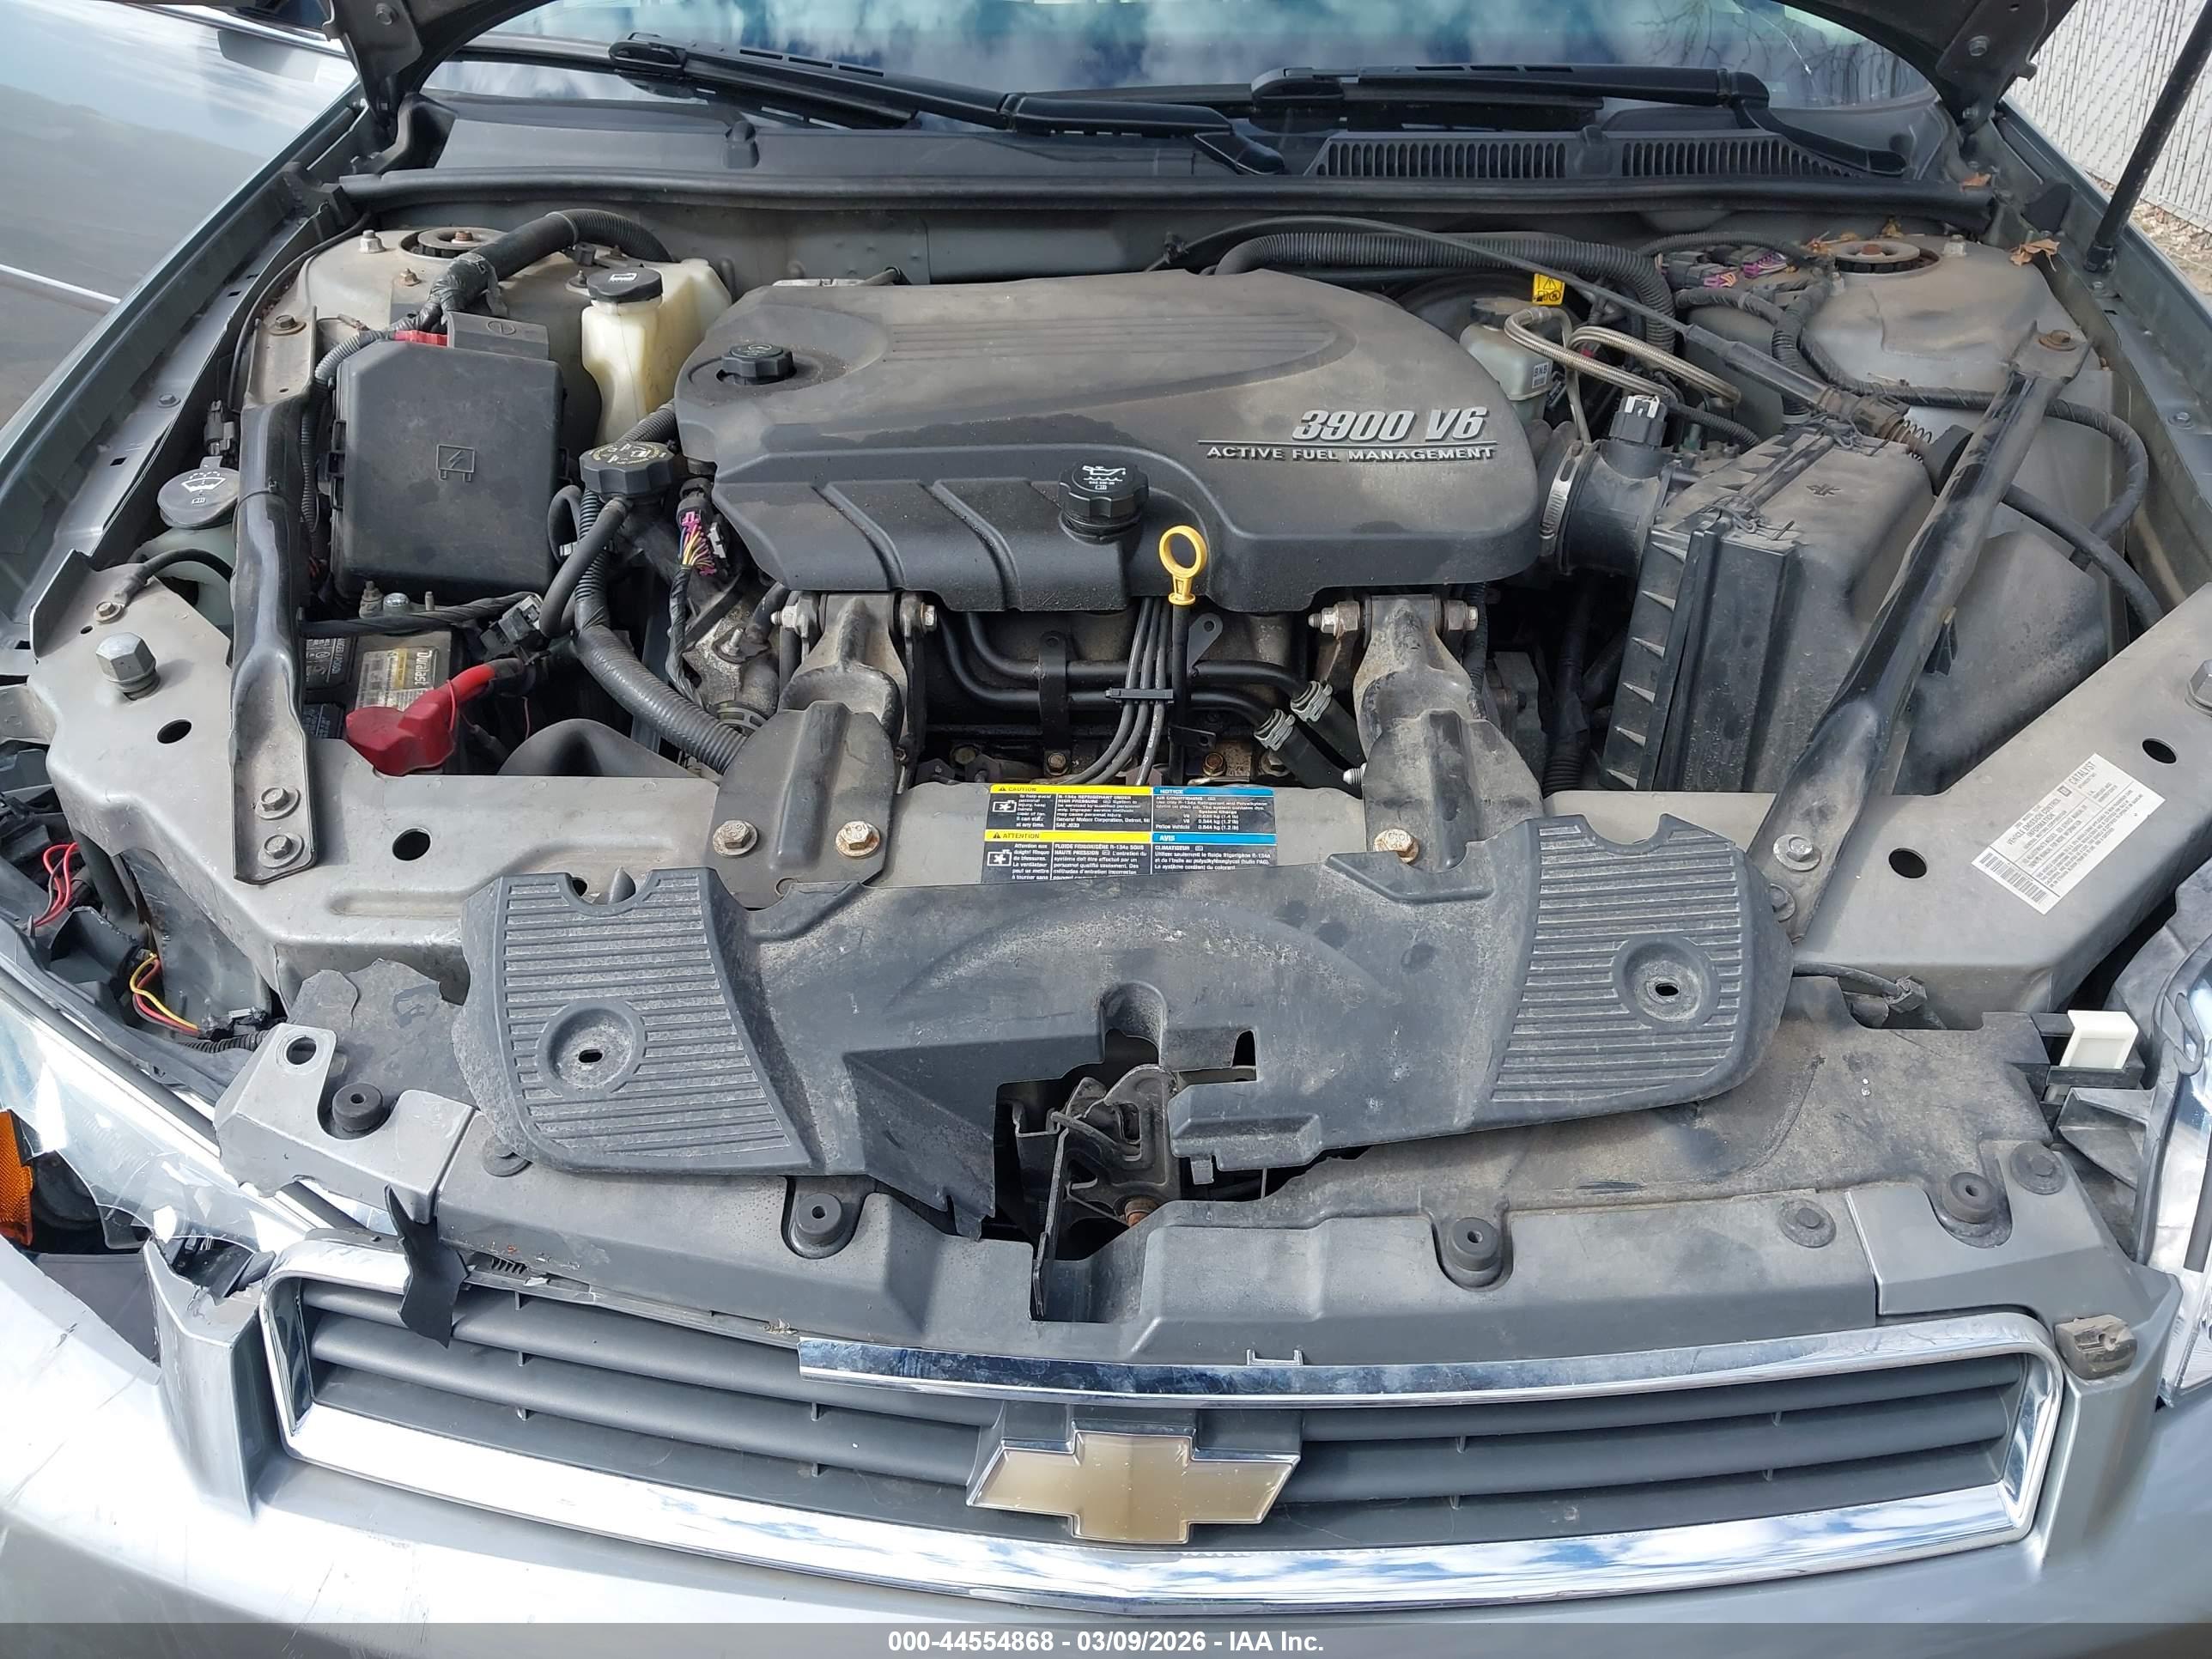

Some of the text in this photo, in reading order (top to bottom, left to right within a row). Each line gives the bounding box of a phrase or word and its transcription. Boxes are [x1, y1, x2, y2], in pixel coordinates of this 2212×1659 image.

[1292, 406, 1490, 441] 3900 V6
[1206, 447, 1497, 462] ACTIVE FUEL MANAGEMENT
[414, 650, 433, 686] Duralast
[2067, 760, 2097, 786] CATALYST
